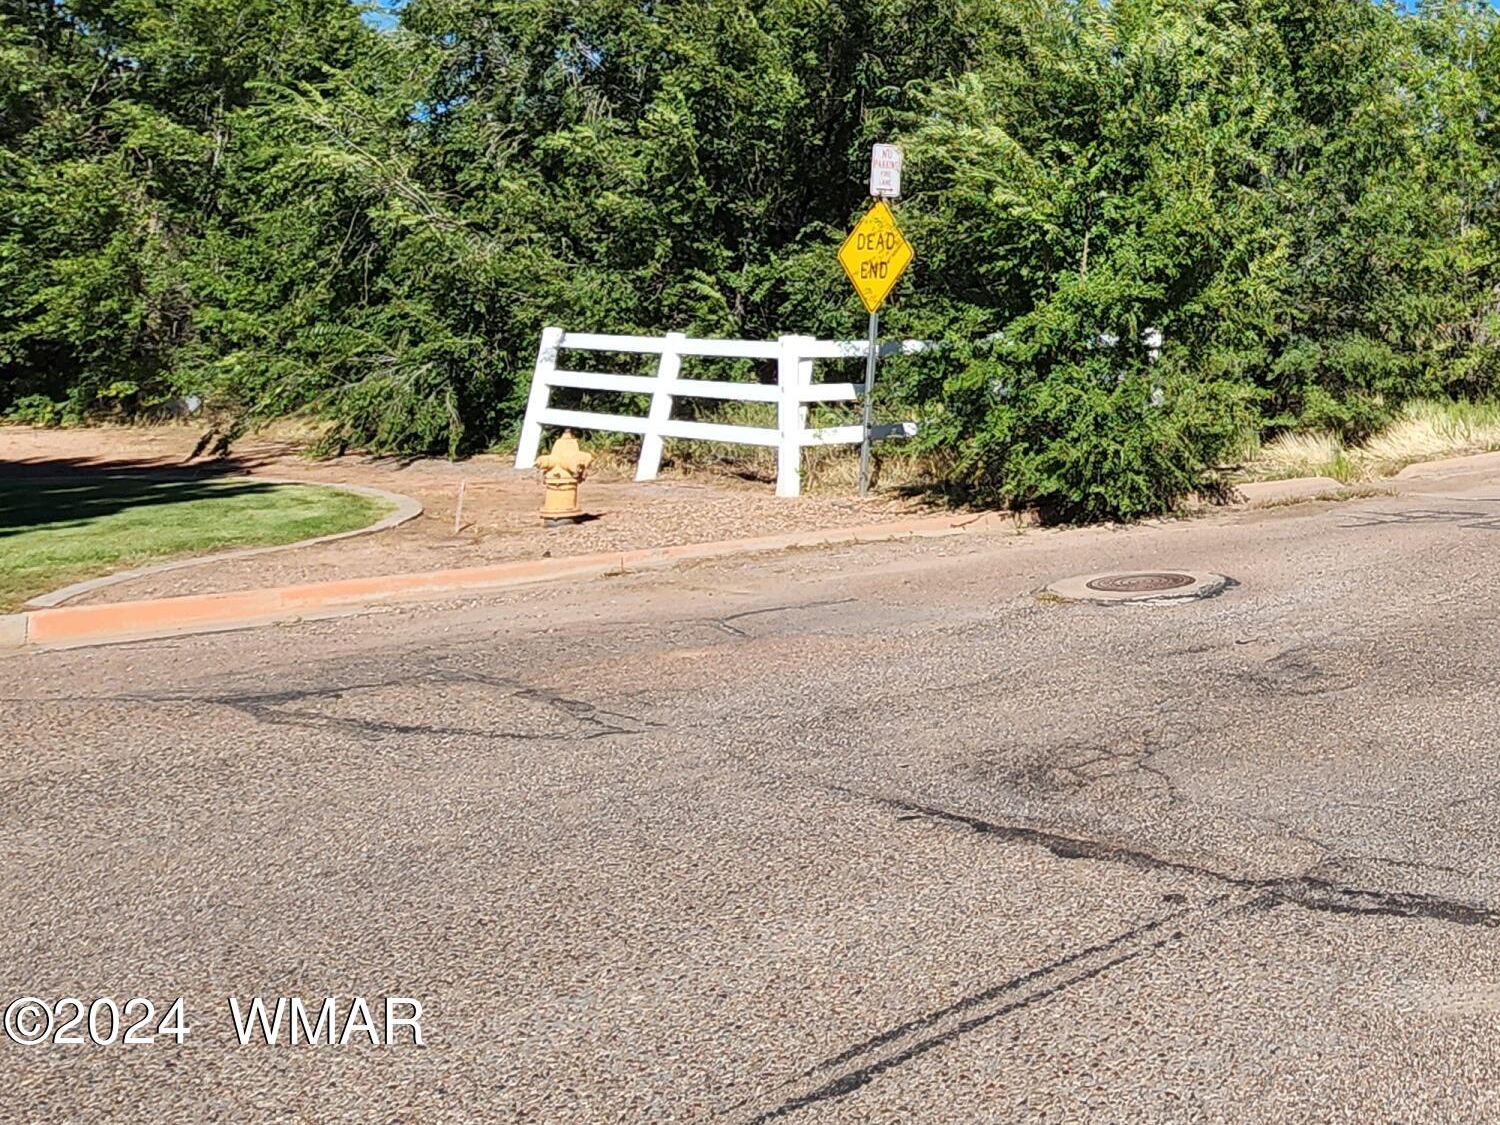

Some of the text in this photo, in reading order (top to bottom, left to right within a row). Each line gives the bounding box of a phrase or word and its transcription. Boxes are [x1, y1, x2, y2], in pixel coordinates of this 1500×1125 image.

[882, 149, 893, 159] NO
[874, 160, 900, 170] PARKING
[857, 233, 895, 250] DEAD
[860, 261, 888, 279] END
